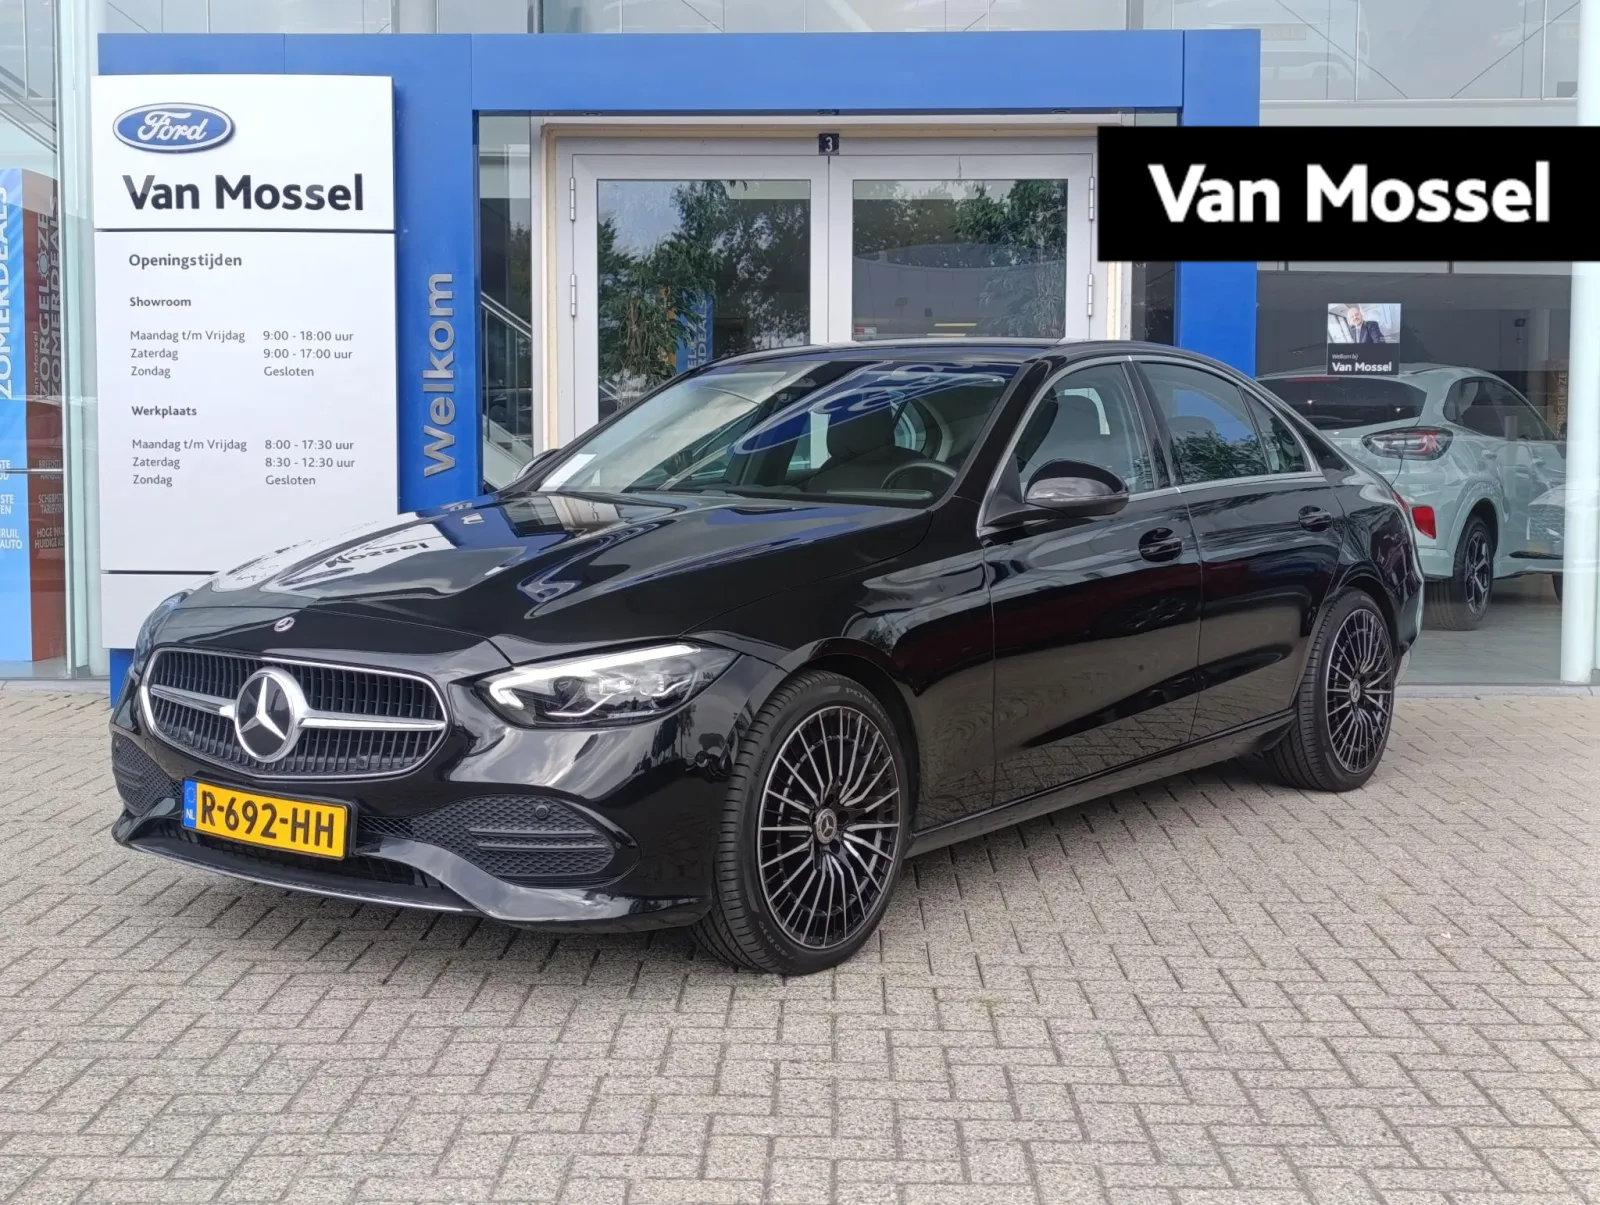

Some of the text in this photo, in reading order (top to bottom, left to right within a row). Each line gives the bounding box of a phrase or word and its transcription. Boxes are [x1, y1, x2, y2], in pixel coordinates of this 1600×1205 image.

[137, 110, 209, 141] Ford
[825, 136, 833, 152] 3
[122, 172, 364, 212] Van Mossel
[128, 252, 243, 271] Openingstijden
[129, 295, 192, 307] Showroom
[130, 329, 179, 344] Maandag
[181, 329, 203, 342] t/m
[204, 329, 246, 344] Vrijdag
[262, 330, 289, 341] 9:00
[299, 330, 332, 342] 18:00
[334, 333, 354, 342] uur
[130, 347, 179, 362] Zaterdag
[263, 348, 290, 359] 9:00
[299, 348, 331, 360] 17:00
[333, 351, 353, 360] uur
[130, 365, 315, 380] Zondag Gesloten
[1331, 361, 1392, 372] Van Mossel
[422, 273, 456, 478] Welkom
[130, 405, 198, 420] Werkplaats
[131, 438, 182, 453] Maandag
[183, 438, 204, 450] t/m
[206, 438, 248, 453] Vrijdag
[264, 439, 291, 450] 8:00
[301, 439, 333, 450] 17:30
[335, 442, 355, 450] uur
[132, 456, 181, 471] Zaterdag
[264, 457, 291, 468] 8:30
[301, 457, 334, 468] 12:30
[336, 460, 356, 468] uur
[132, 474, 316, 488] Zondag Gesloten
[185, 808, 196, 821] NL
[200, 789, 335, 849] R-692-HH
